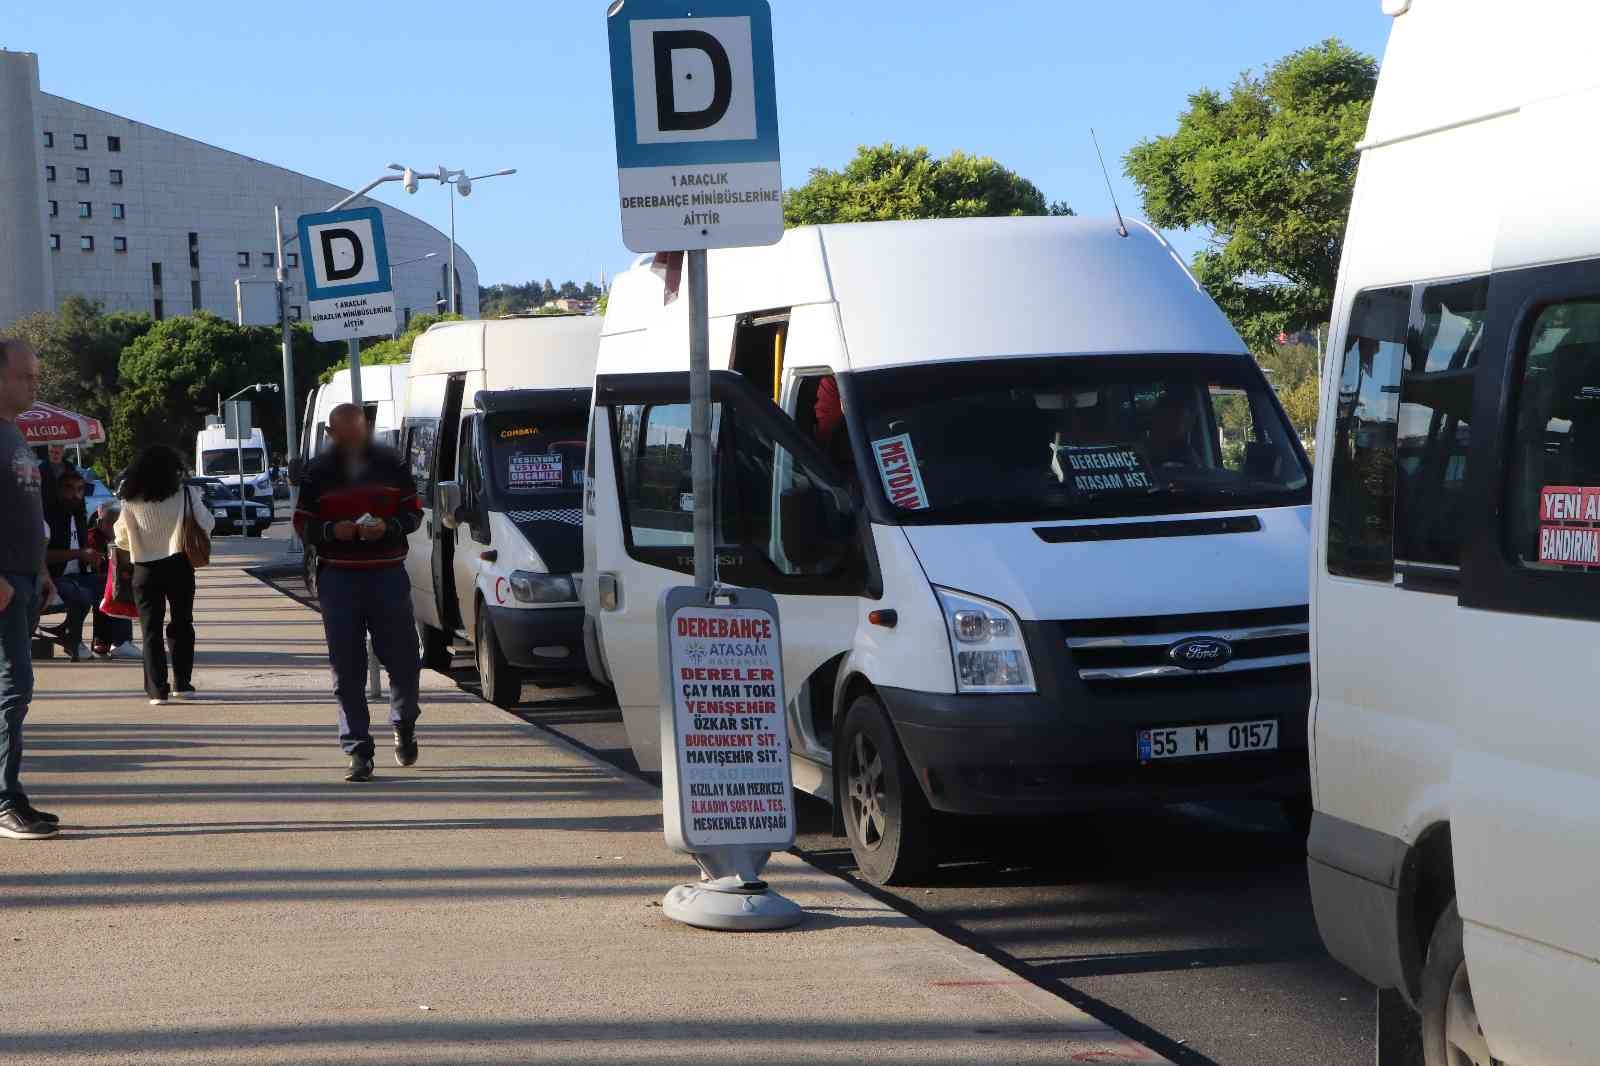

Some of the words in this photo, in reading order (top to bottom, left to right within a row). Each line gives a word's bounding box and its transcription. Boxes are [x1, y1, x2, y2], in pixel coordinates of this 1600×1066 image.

[653, 30, 732, 131] D
[672, 176, 677, 187] 1
[680, 172, 728, 187] ARAÇLIK
[622, 194, 689, 209] DEREBAHÇE
[692, 187, 779, 205] MİNİBÜSLERİNE
[683, 210, 720, 226] AİTTİR
[320, 228, 364, 281] D
[27, 425, 67, 437] ALGIDA
[1069, 451, 1139, 471] DEREBAHÇE
[1075, 474, 1123, 490] ATASAM
[1124, 472, 1152, 488] HST.
[1541, 529, 1598, 562] BANDIRMA
[677, 617, 771, 642] DEREBAHÇE
[710, 643, 768, 657] ATASAM
[1186, 640, 1219, 658] Ford
[680, 667, 774, 680] DERELER
[682, 684, 707, 699] ÇAY
[712, 684, 740, 698] MAH
[744, 684, 776, 698] TOKİ
[685, 700, 776, 716] YENİŞEHİR
[694, 714, 737, 730] ÖZKAR
[741, 717, 768, 731] SİT.
[685, 734, 753, 747] BURCUKENT
[1153, 731, 1177, 755] 55
[1195, 728, 1208, 752] M
[1229, 724, 1273, 749] 0157
[758, 750, 782, 763] SİT.
[691, 783, 723, 796] KIZILAY
[726, 783, 746, 796] KAN
[730, 800, 765, 812] SOSYAL
[694, 816, 749, 830] MESKENLER
